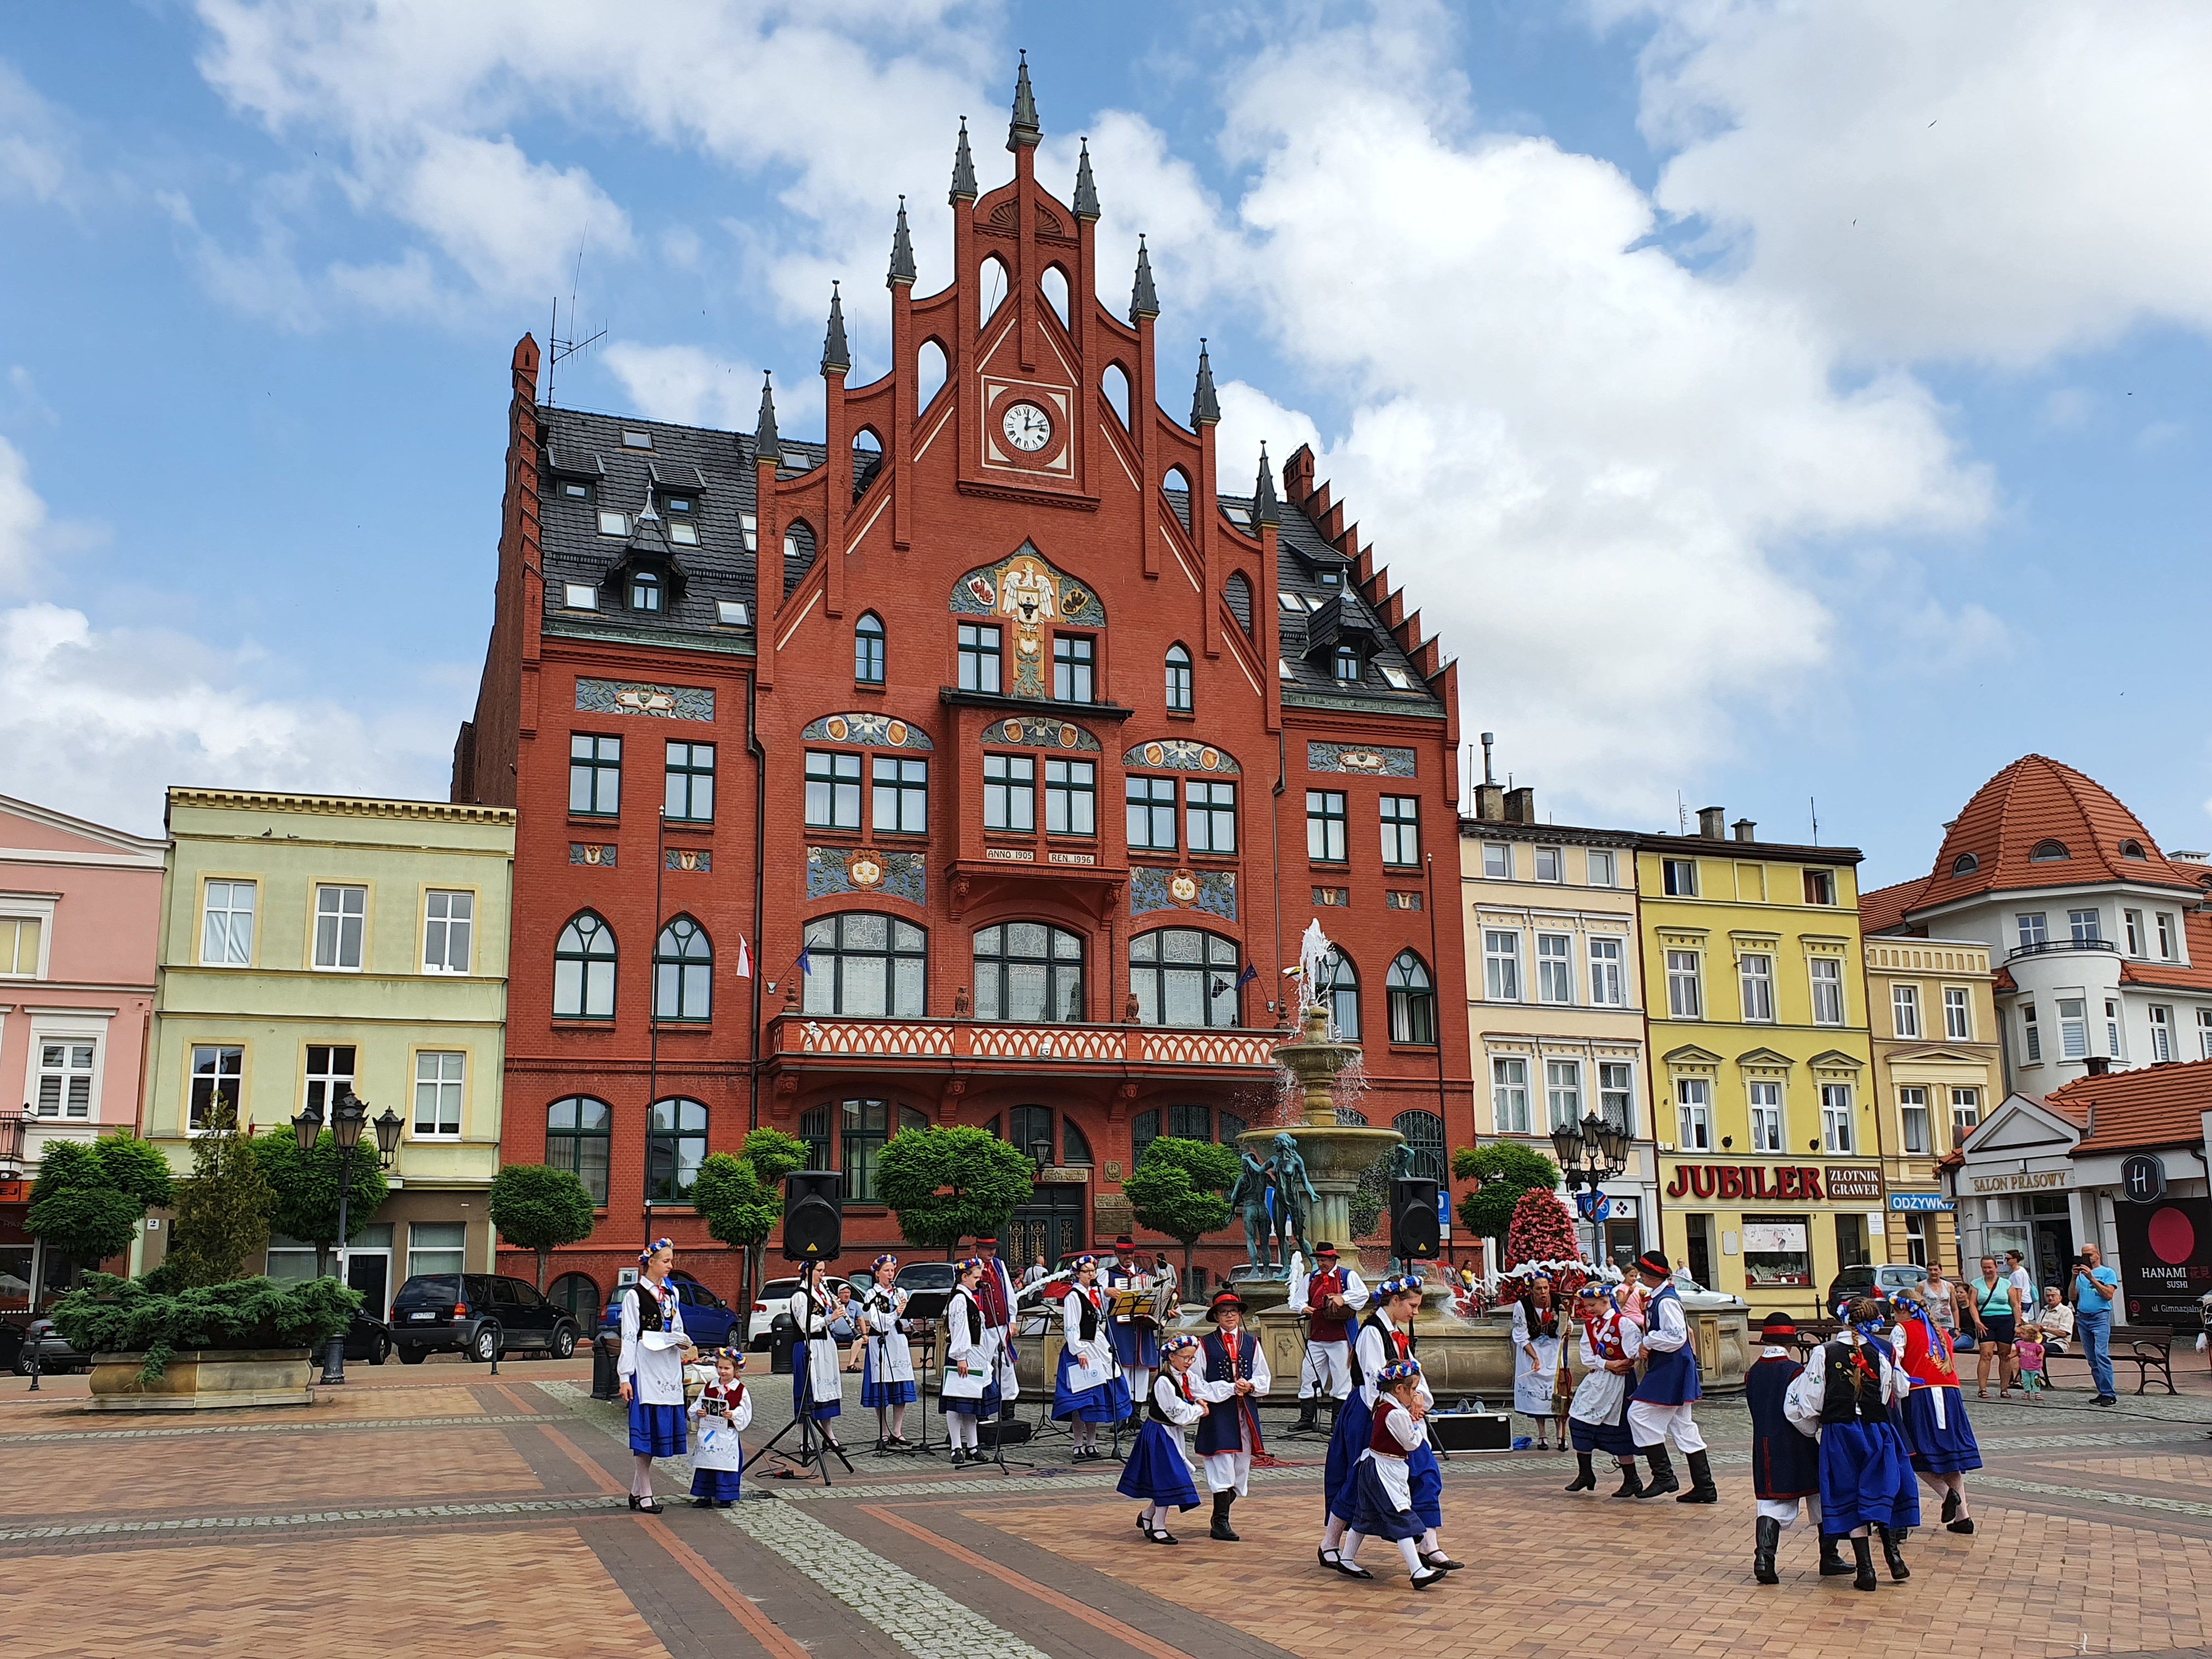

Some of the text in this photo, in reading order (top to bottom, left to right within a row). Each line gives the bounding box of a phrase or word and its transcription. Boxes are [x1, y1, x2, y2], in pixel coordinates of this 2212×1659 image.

[1074, 855, 1091, 864] 1996
[1830, 1170, 1878, 1181] ZŁOTNIK
[2131, 1164, 2147, 1193] H
[1667, 1165, 1825, 1199] JUBILER
[1974, 1172, 2066, 1192] SALON PRASOWY
[1832, 1184, 1879, 1195] GRAWER
[2142, 1267, 2187, 1278] HANAMI
